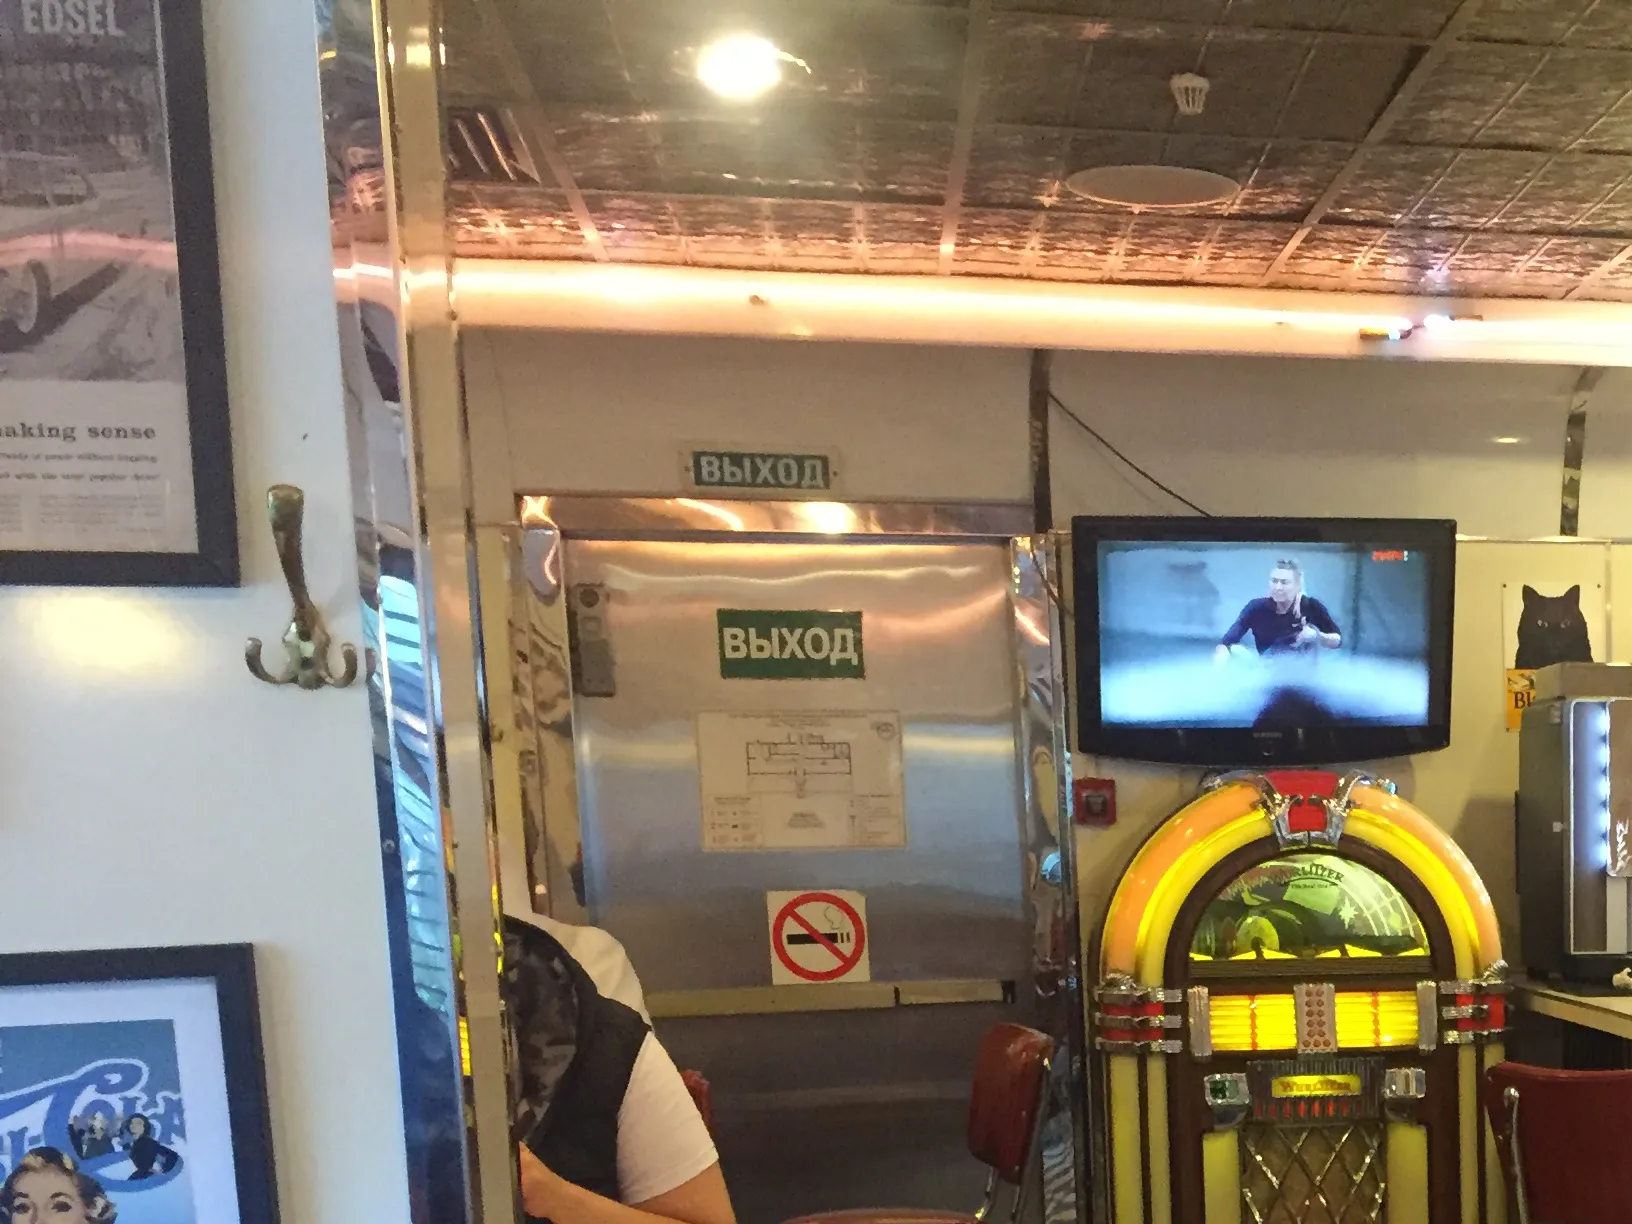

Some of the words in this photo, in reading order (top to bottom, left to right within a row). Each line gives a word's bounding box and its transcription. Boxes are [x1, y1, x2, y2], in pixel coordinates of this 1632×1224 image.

[21, 0, 126, 36] EDSEL
[0, 422, 76, 442] aking
[88, 426, 156, 439] sense
[699, 455, 825, 489] ВЫХОД
[722, 626, 859, 666] ВЫХОД
